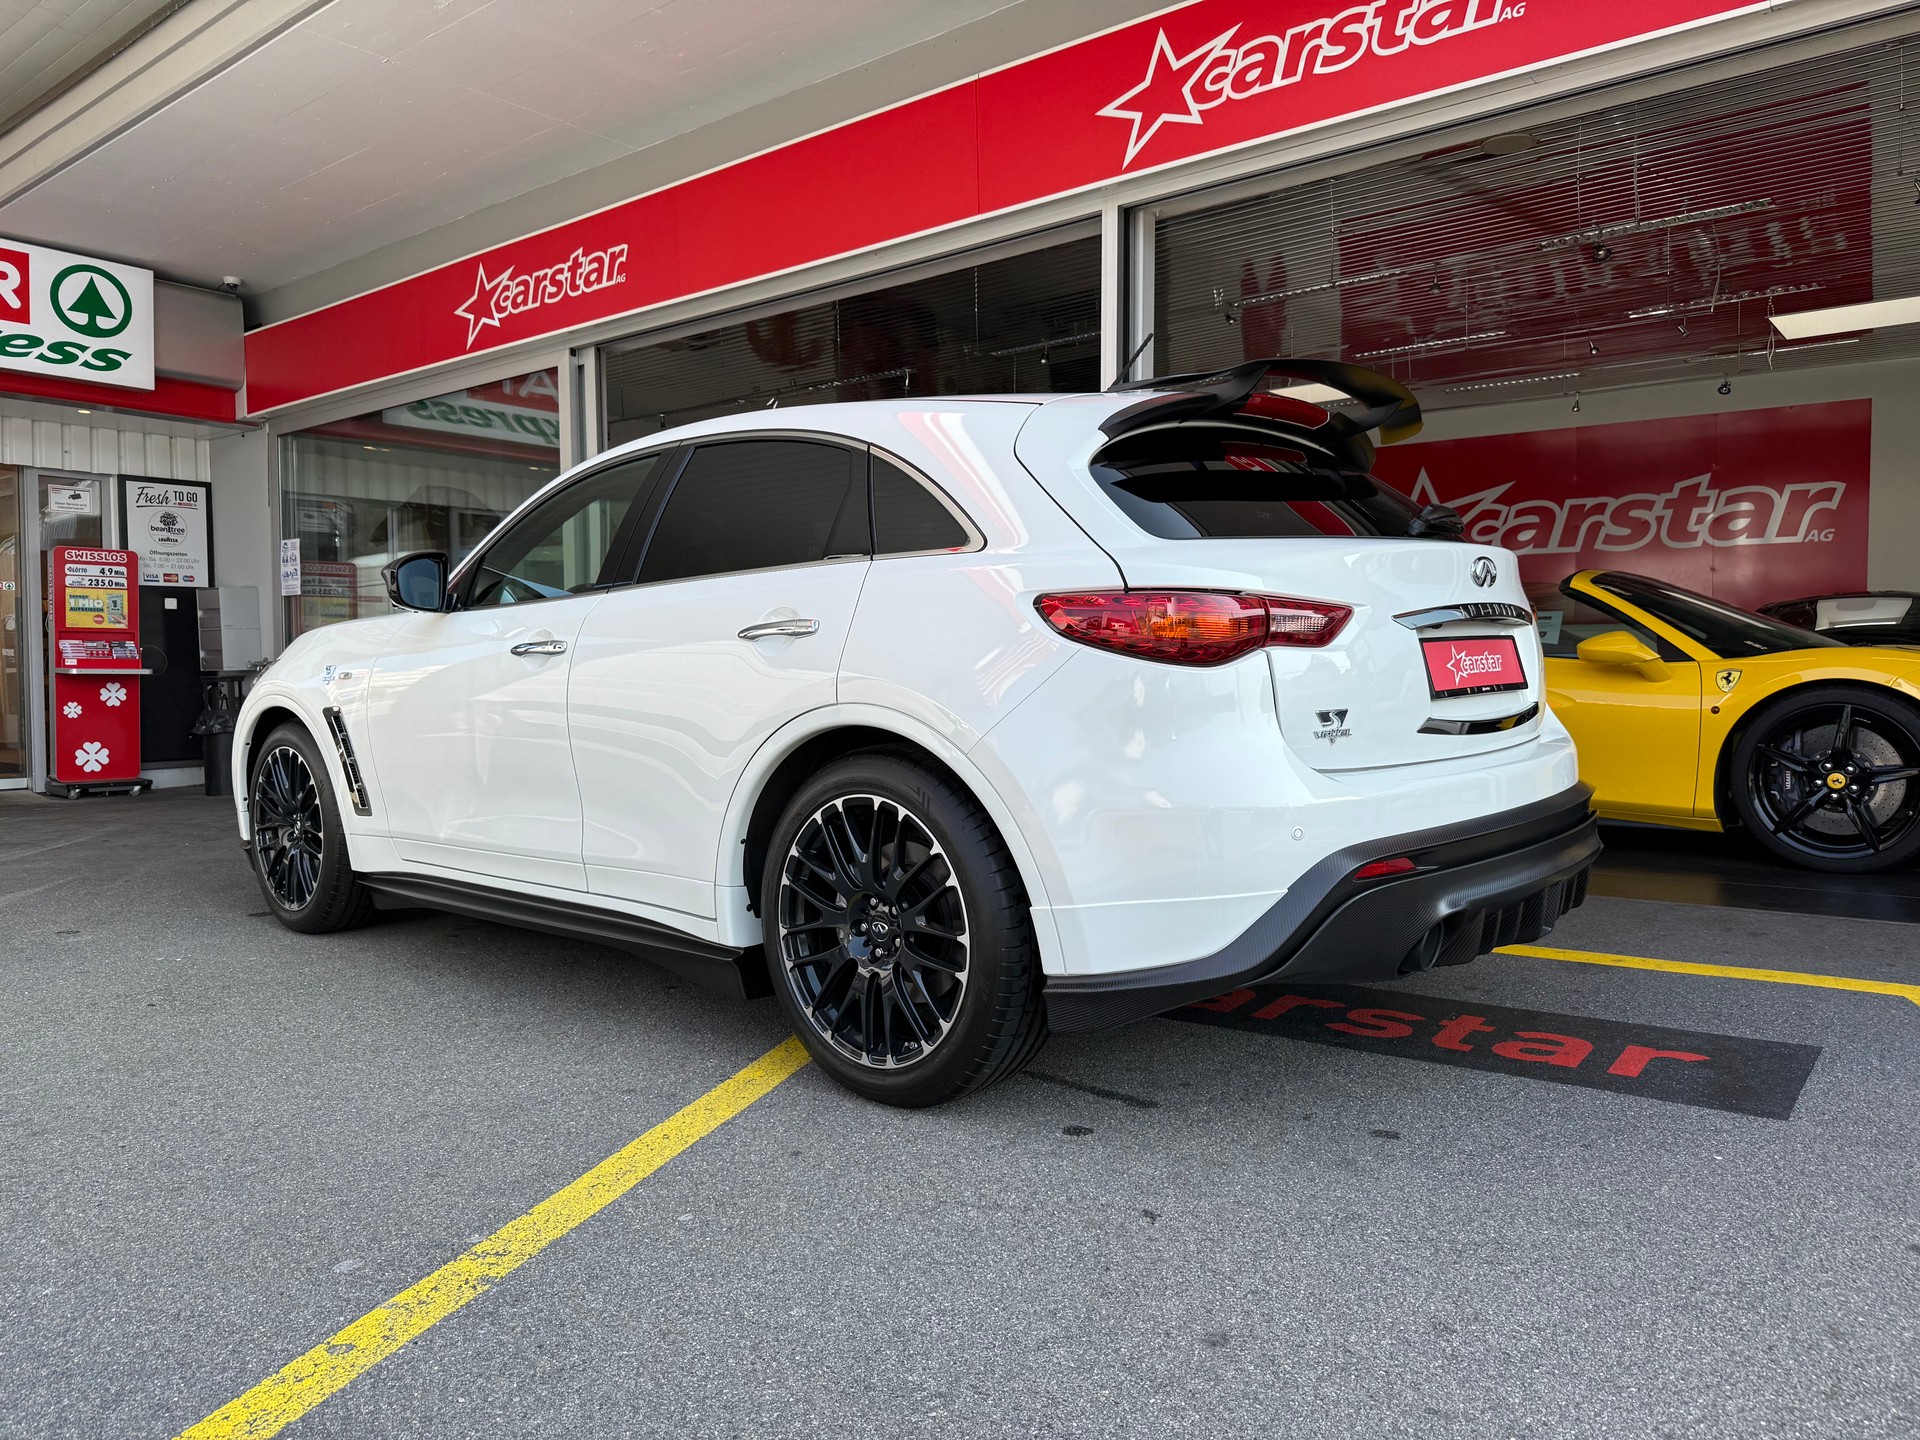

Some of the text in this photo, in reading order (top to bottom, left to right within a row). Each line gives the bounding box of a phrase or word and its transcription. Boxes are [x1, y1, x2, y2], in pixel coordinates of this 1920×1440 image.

[1499, 2, 1527, 22] AG
[494, 244, 628, 318] carstar AG
[0, 331, 133, 371] ess
[136, 486, 171, 505] Fresh
[173, 491, 184, 502] TO
[186, 492, 198, 503] GO
[1469, 473, 1846, 556] carstar AG
[66, 551, 126, 562] SWISSLOS
[149, 549, 188, 557] Öffnungszeiten
[1461, 651, 1501, 674] carstar
